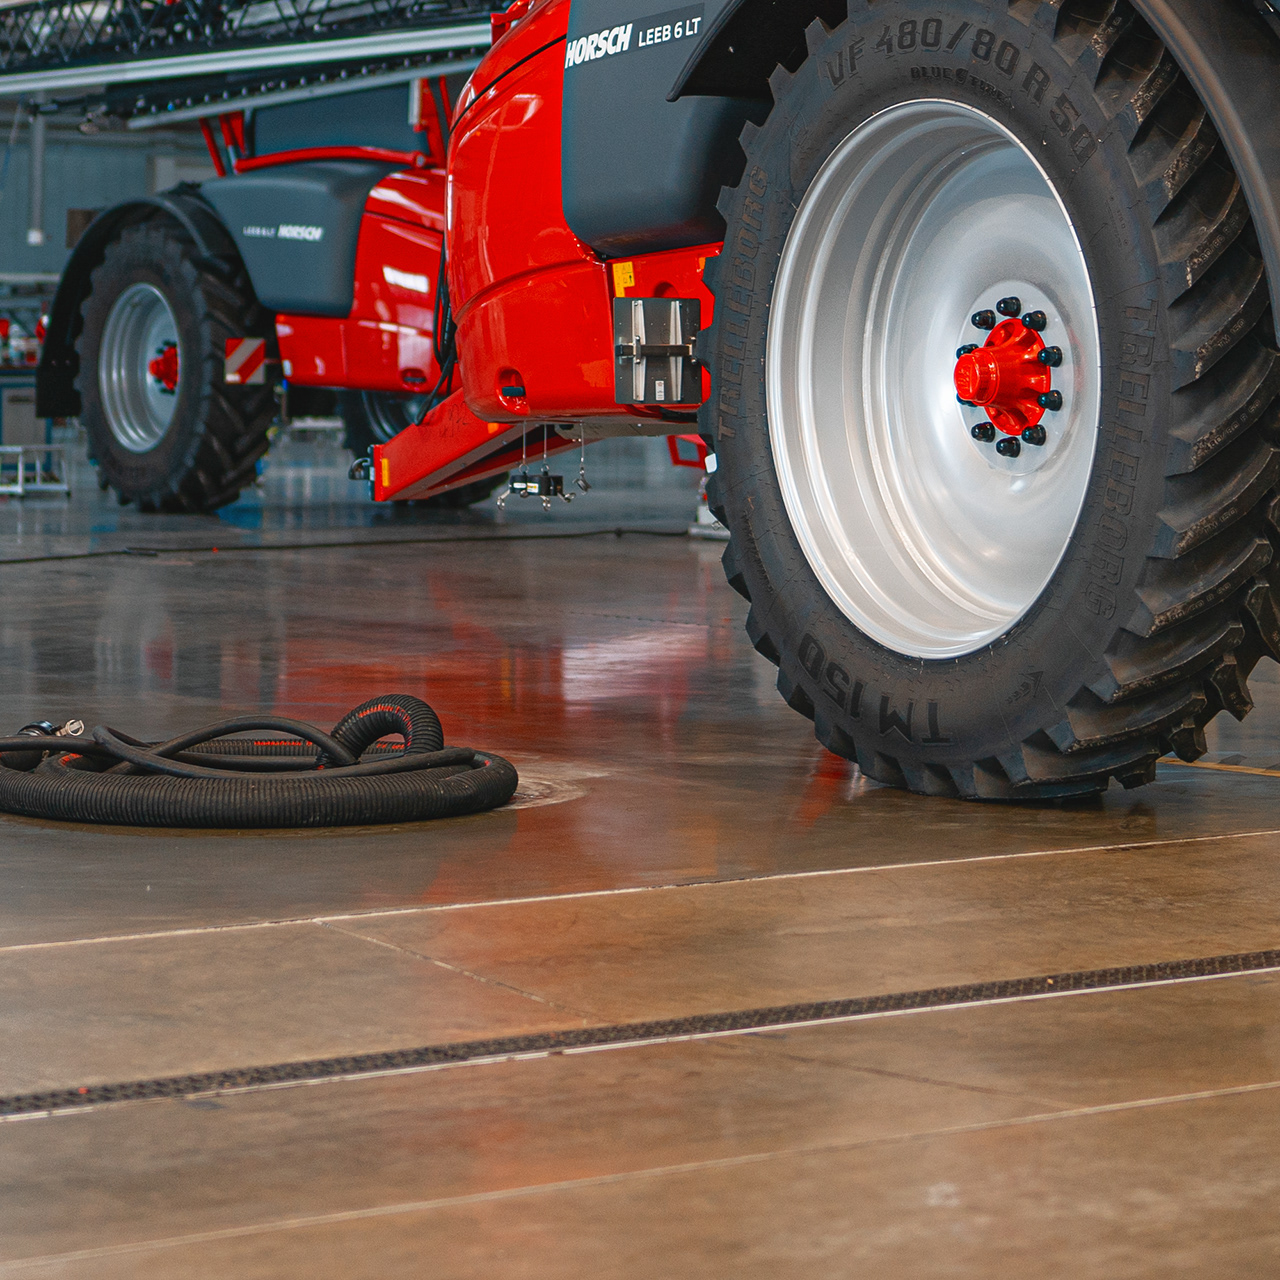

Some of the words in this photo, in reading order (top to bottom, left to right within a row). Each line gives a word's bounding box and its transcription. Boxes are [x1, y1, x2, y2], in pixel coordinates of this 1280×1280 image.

[564, 23, 633, 69] HORSCH
[638, 24, 671, 47] LEEB
[673, 21, 683, 39] 6
[685, 17, 702, 36] LT
[826, 37, 865, 90] VF
[874, 18, 1021, 80] 480/80
[1022, 61, 1052, 108] R
[1049, 93, 1098, 167] 50
[278, 224, 323, 240] HORSCH
[717, 165, 769, 442] TRELLEBORG
[1082, 298, 1158, 621] TRELLEBORG
